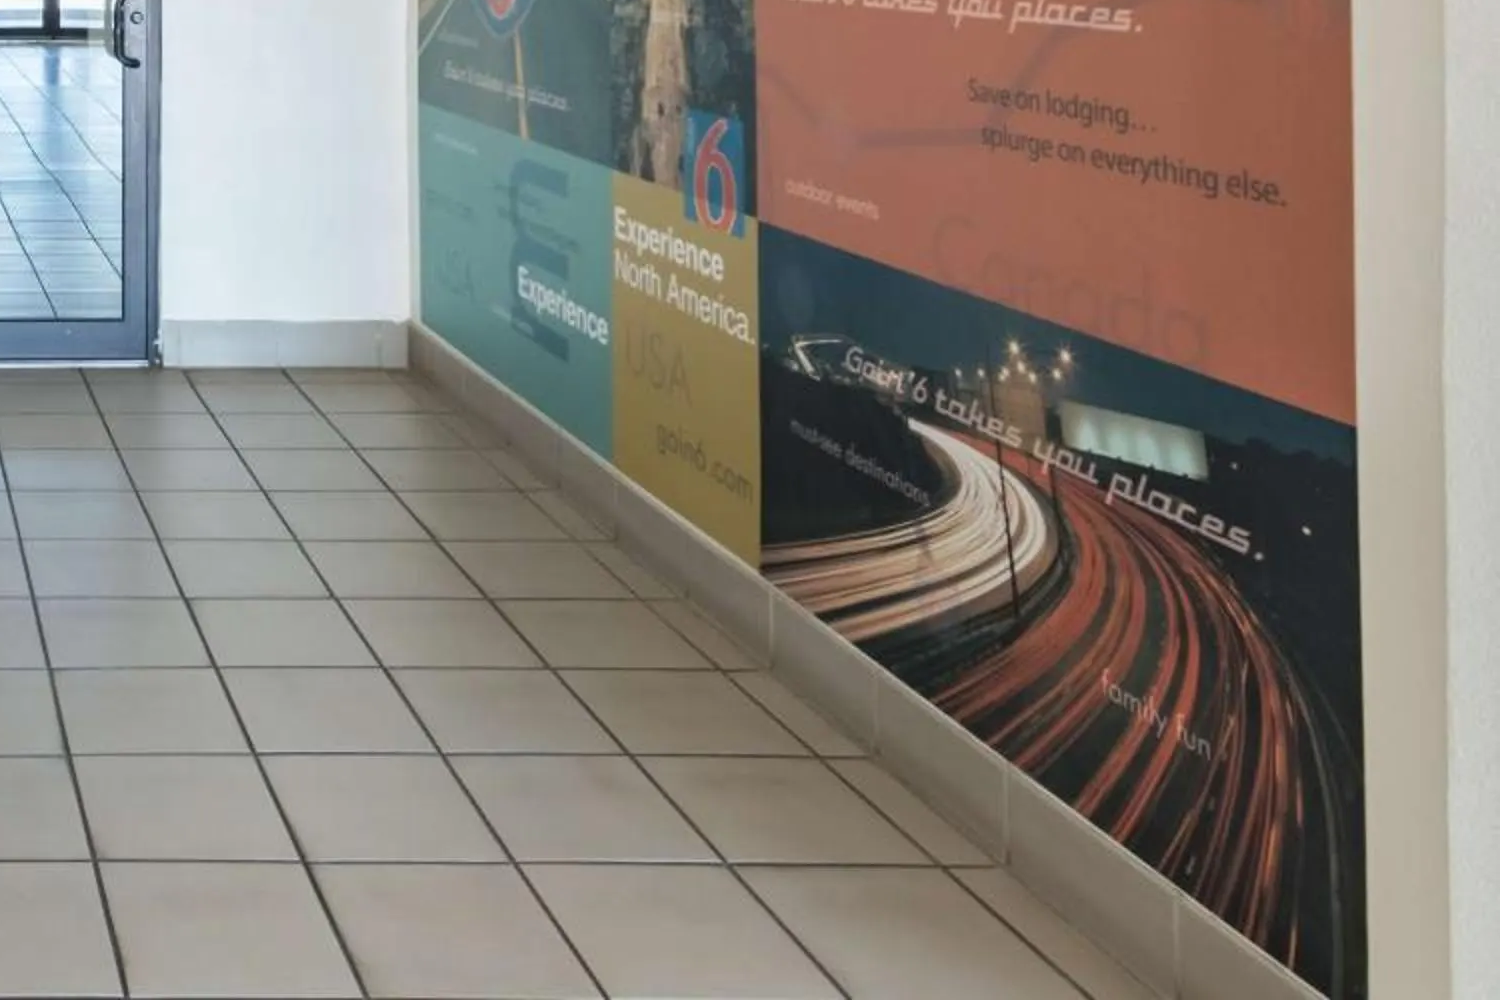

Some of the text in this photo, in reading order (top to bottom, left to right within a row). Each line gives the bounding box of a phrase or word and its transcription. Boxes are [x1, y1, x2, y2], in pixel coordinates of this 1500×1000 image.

[967, 77, 1012, 107] Save
[1016, 90, 1041, 112] on
[694, 118, 738, 235] 6
[980, 123, 1288, 207] splurge on everything else.
[614, 205, 724, 281] Experience
[517, 265, 609, 345] Experience
[614, 247, 755, 344] North America.
[625, 319, 692, 408] USA
[933, 388, 1023, 448] takes
[1032, 441, 1100, 485] you
[1105, 472, 1266, 561] places.
[1101, 667, 1211, 761] family fun
